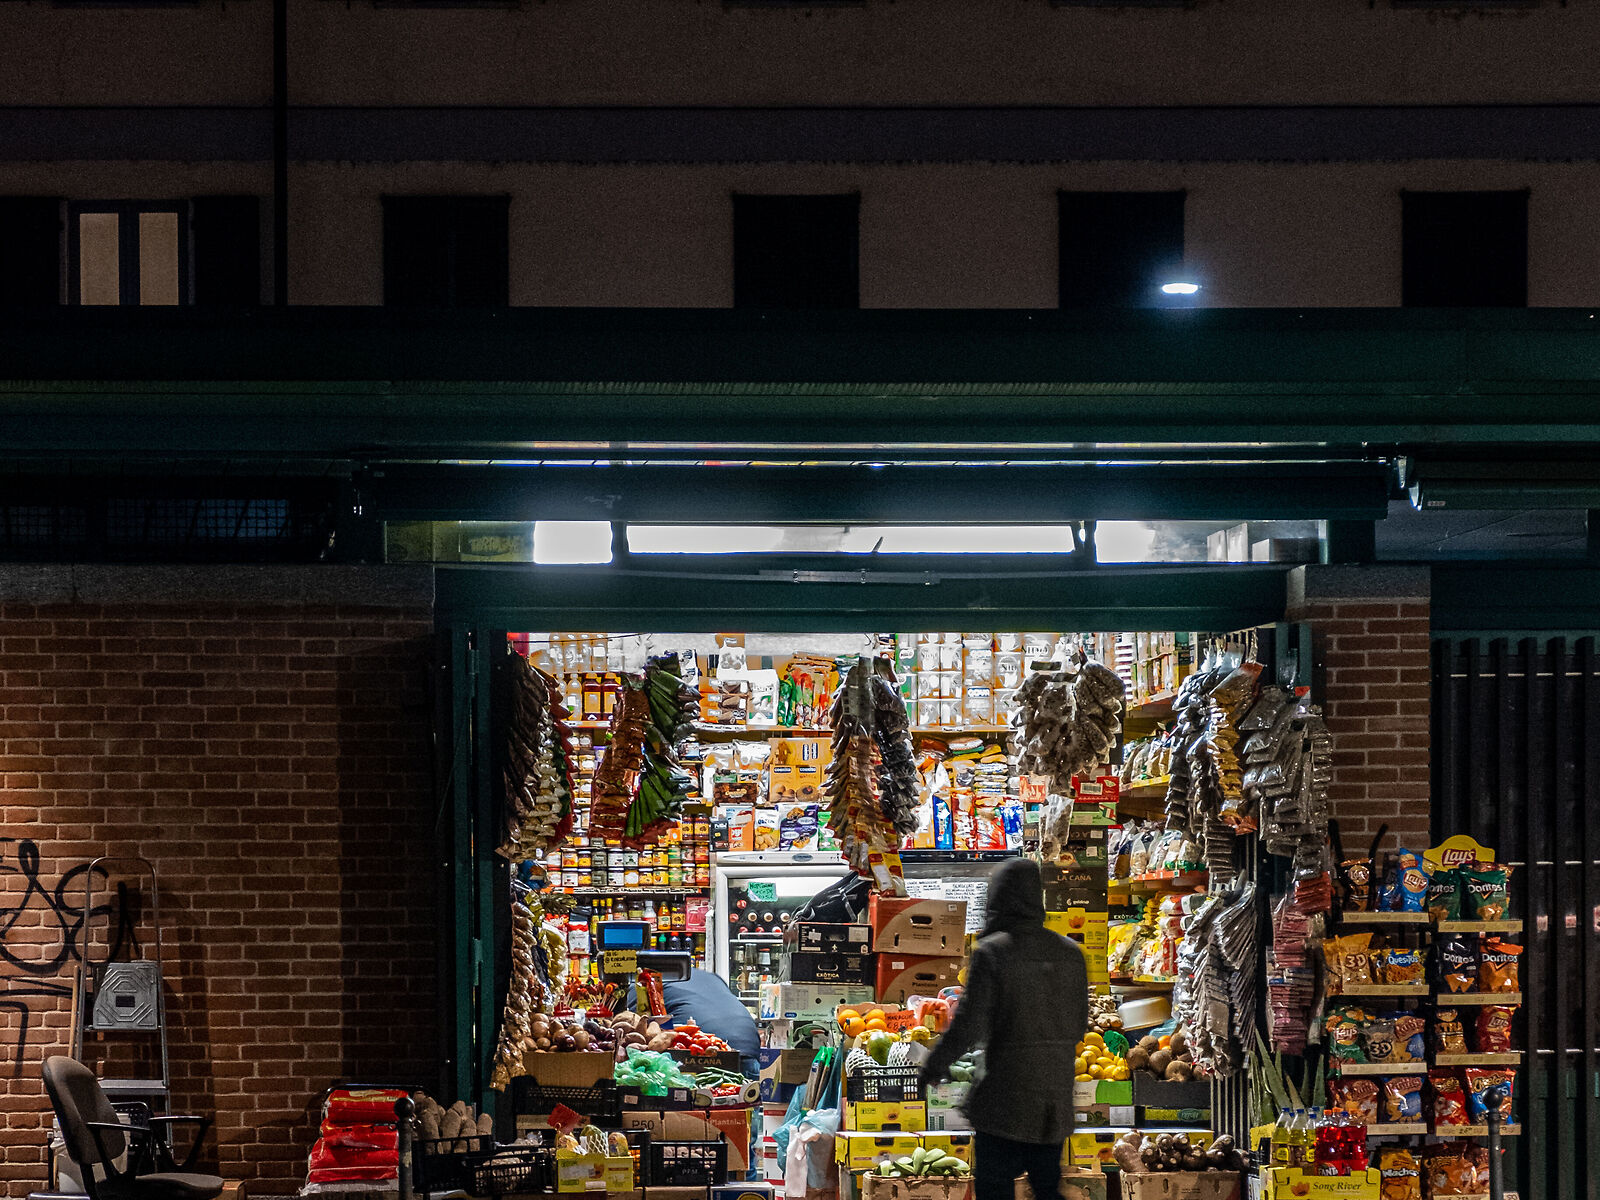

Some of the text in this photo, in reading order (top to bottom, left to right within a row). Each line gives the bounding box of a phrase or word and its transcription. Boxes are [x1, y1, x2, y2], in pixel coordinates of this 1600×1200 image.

[1468, 883, 1503, 893] Doritos
[1481, 952, 1518, 963] Doritos
[631, 1120, 655, 1130] P50
[1313, 1182, 1362, 1191] Song River
